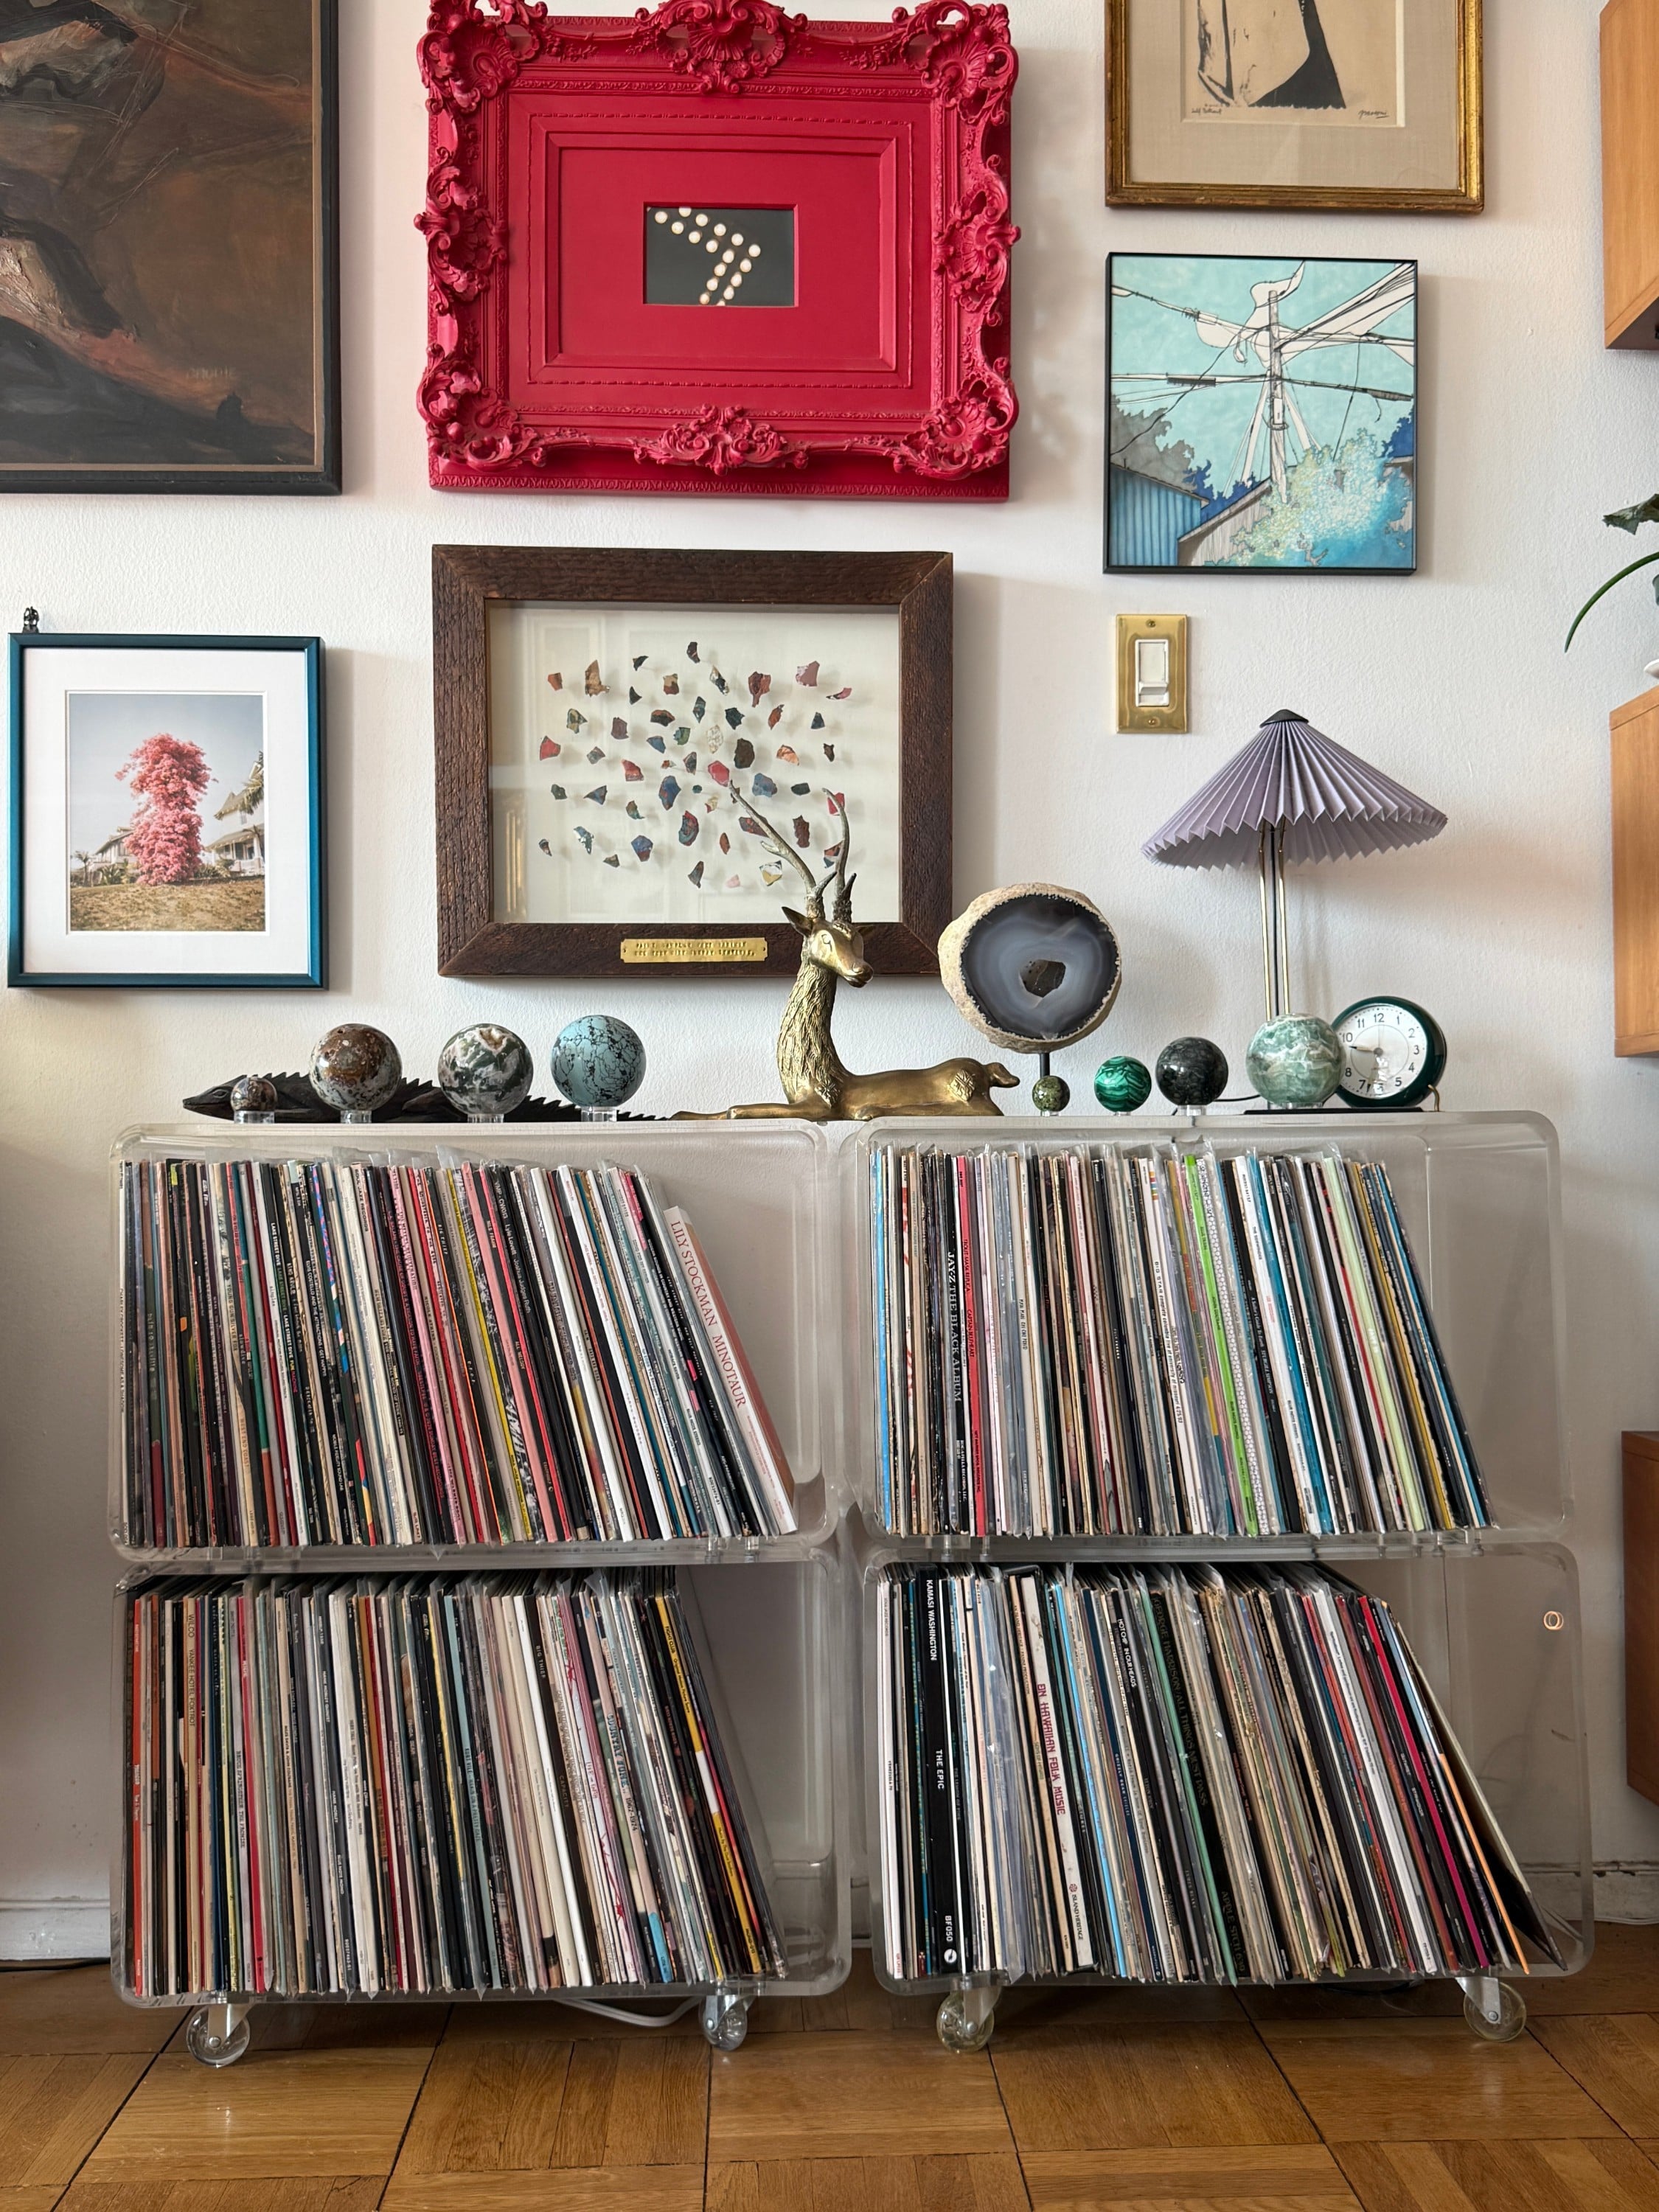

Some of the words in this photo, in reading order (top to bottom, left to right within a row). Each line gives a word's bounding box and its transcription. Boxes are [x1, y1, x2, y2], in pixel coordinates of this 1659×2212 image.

[1357, 1019, 1365, 1028] 11
[1374, 1013, 1385, 1023] 12
[1397, 1016, 1400, 1025] 1
[1343, 1032, 1353, 1042] 10
[1408, 1029, 1416, 1038] 2
[1413, 1045, 1419, 1055] 3
[1345, 1068, 1352, 1077] 8
[1409, 1062, 1414, 1072] 4
[1359, 1079, 1366, 1090] 7
[1395, 1077, 1402, 1087] 5
[947, 1251, 956, 1282] JAY-Z
[669, 1221, 689, 1248] LILY
[680, 1251, 718, 1326] STOCKMAN
[711, 1335, 748, 1408] MINOTAUR
[950, 1315, 959, 1352] BLACK
[952, 1358, 961, 1402] ALBUM
[925, 1579, 935, 1607] KAMASI
[927, 1610, 938, 1660] WASHINGTON
[535, 1645, 543, 1656] BIG
[537, 1660, 546, 1678] THIEF
[187, 1675, 195, 1696] HOTEL
[935, 1749, 943, 1766] THE
[936, 1769, 945, 1789] EPIC
[1053, 1786, 1065, 1815] MUSIC
[1071, 1894, 1079, 1913] ISLAND
[1074, 1915, 1083, 1941] HERITAGE
